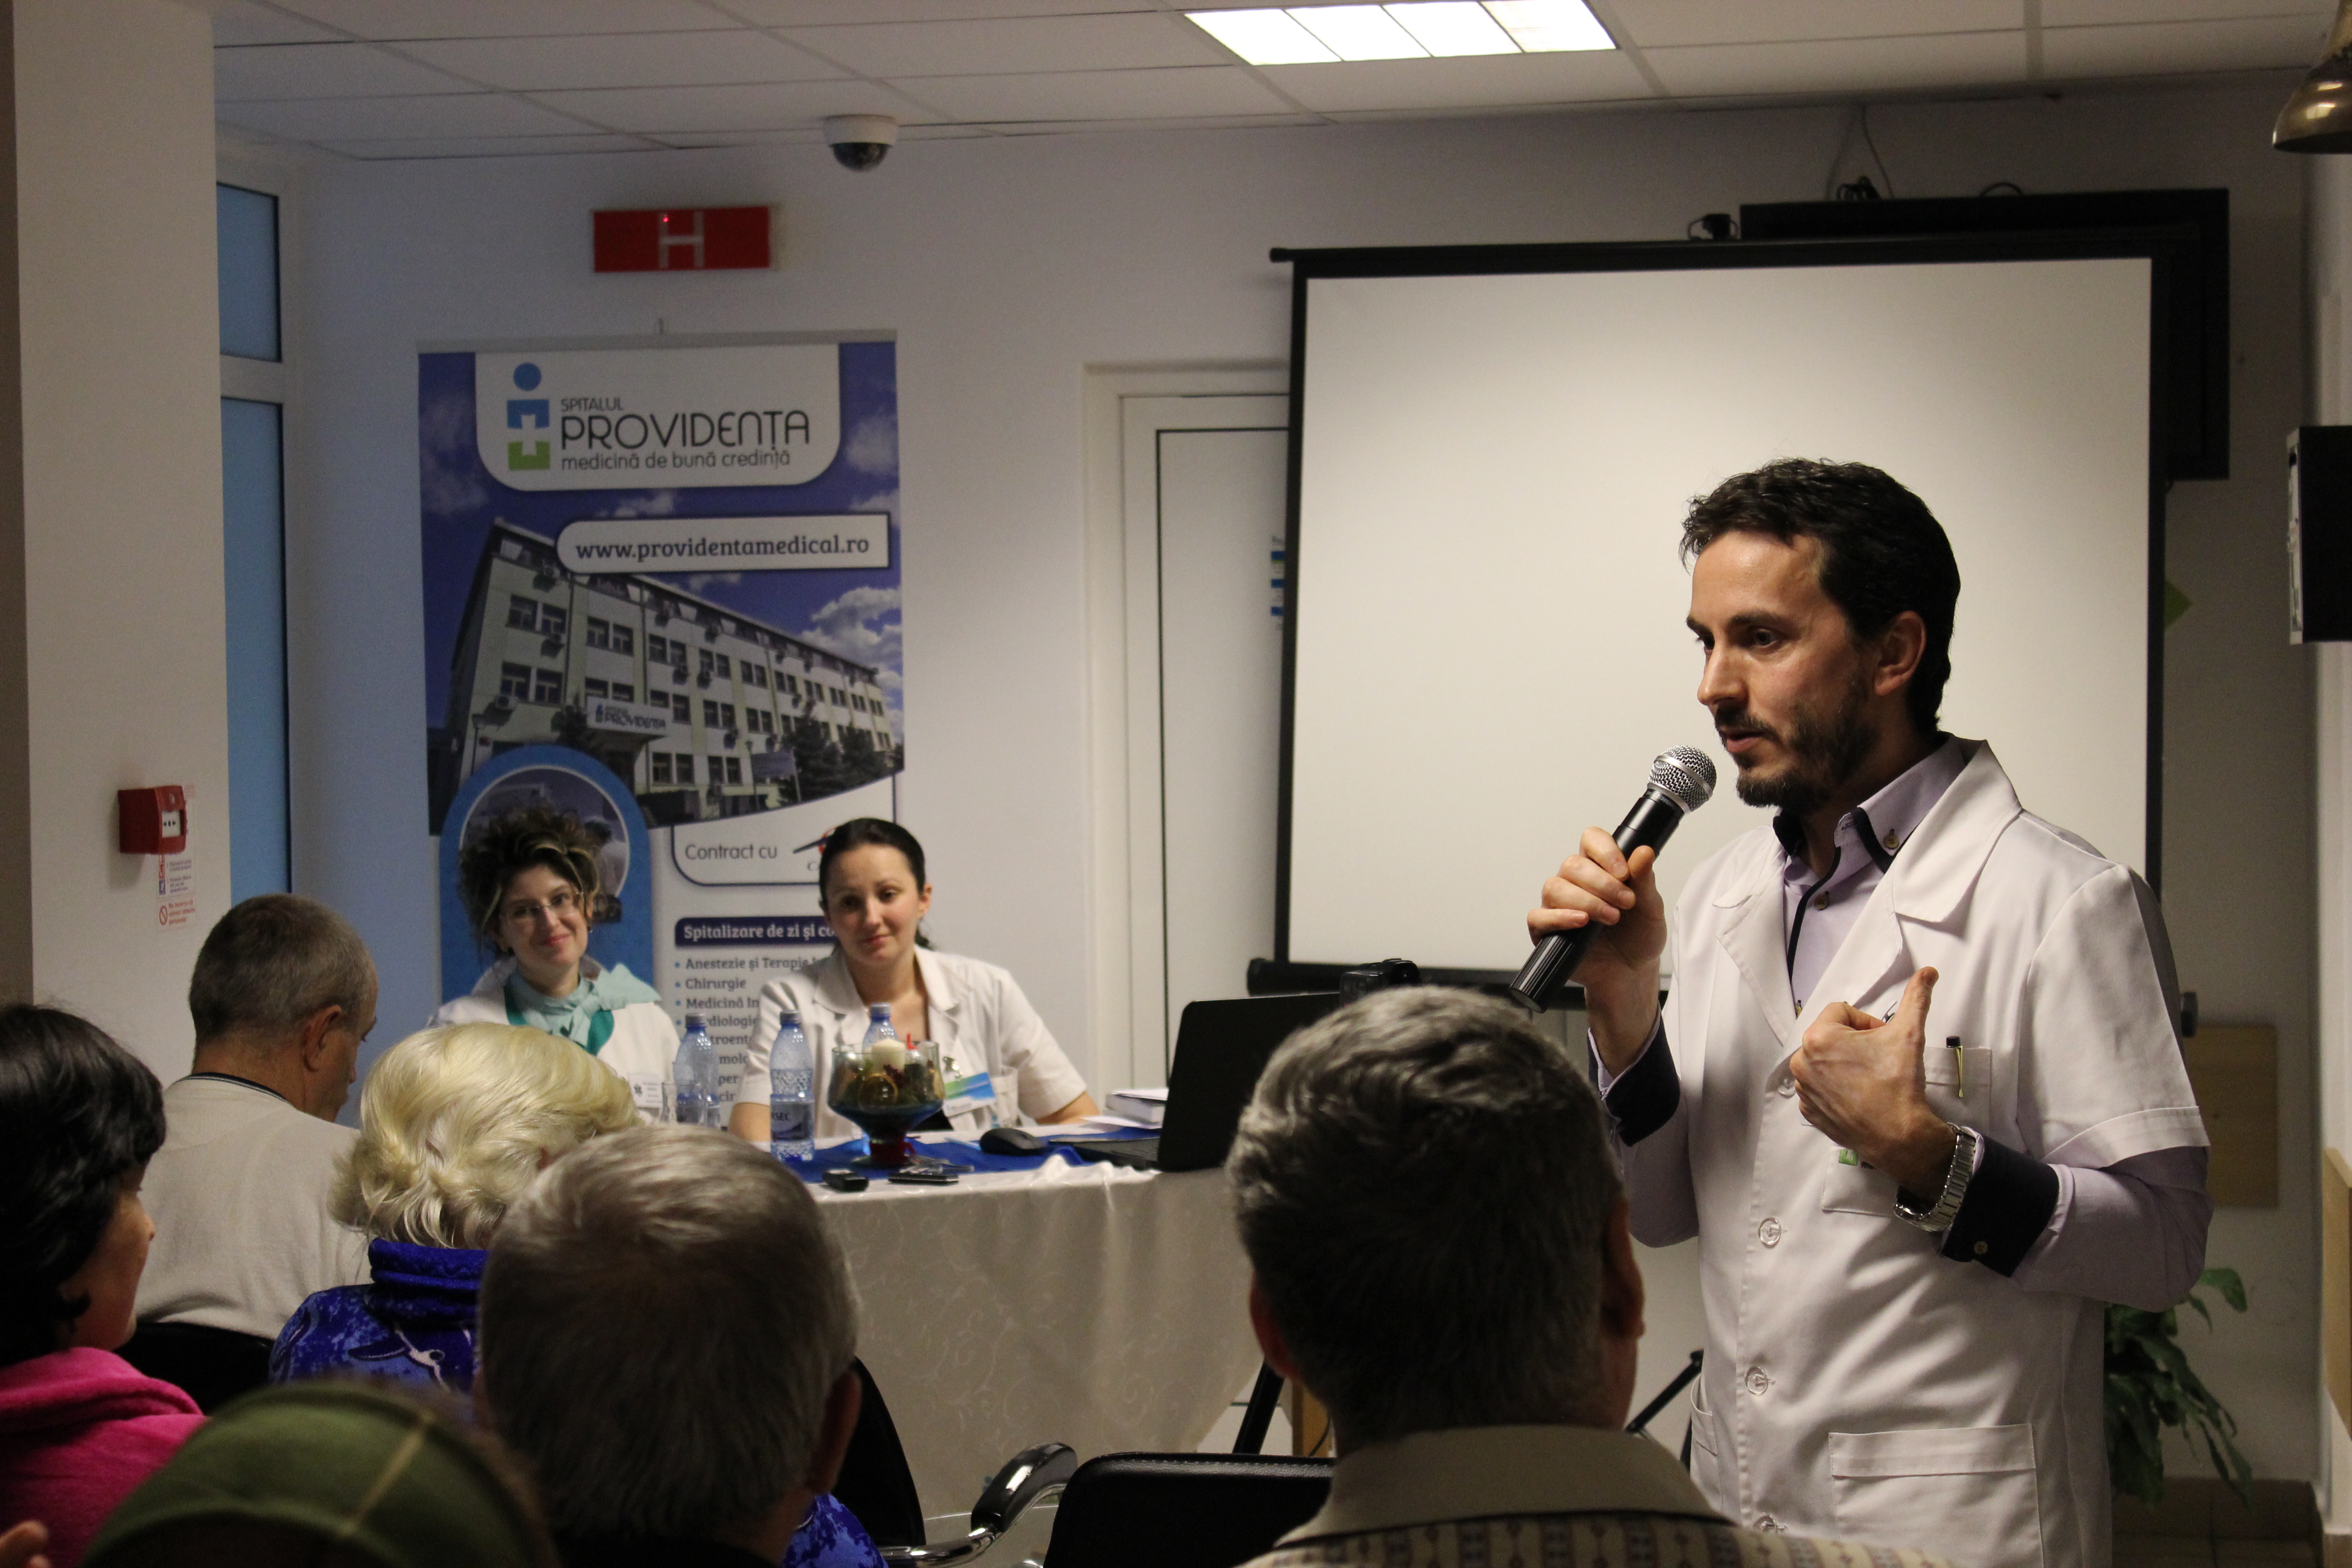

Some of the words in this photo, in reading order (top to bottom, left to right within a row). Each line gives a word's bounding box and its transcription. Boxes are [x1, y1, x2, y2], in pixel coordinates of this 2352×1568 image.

[658, 212, 705, 269] H
[561, 398, 623, 412] SPITALUL
[562, 452, 639, 470] medicină
[646, 452, 668, 469] de
[672, 451, 716, 468] bună
[576, 535, 869, 562] www.providentamedical.ro
[685, 843, 754, 860] Contract
[758, 846, 777, 859] cu
[684, 924, 764, 942] Spitalizare
[767, 924, 784, 938] de
[787, 923, 799, 937] zi
[686, 958, 745, 970] Anestezie
[686, 978, 746, 992] Chirurgie
[686, 998, 744, 1009] Medicină
